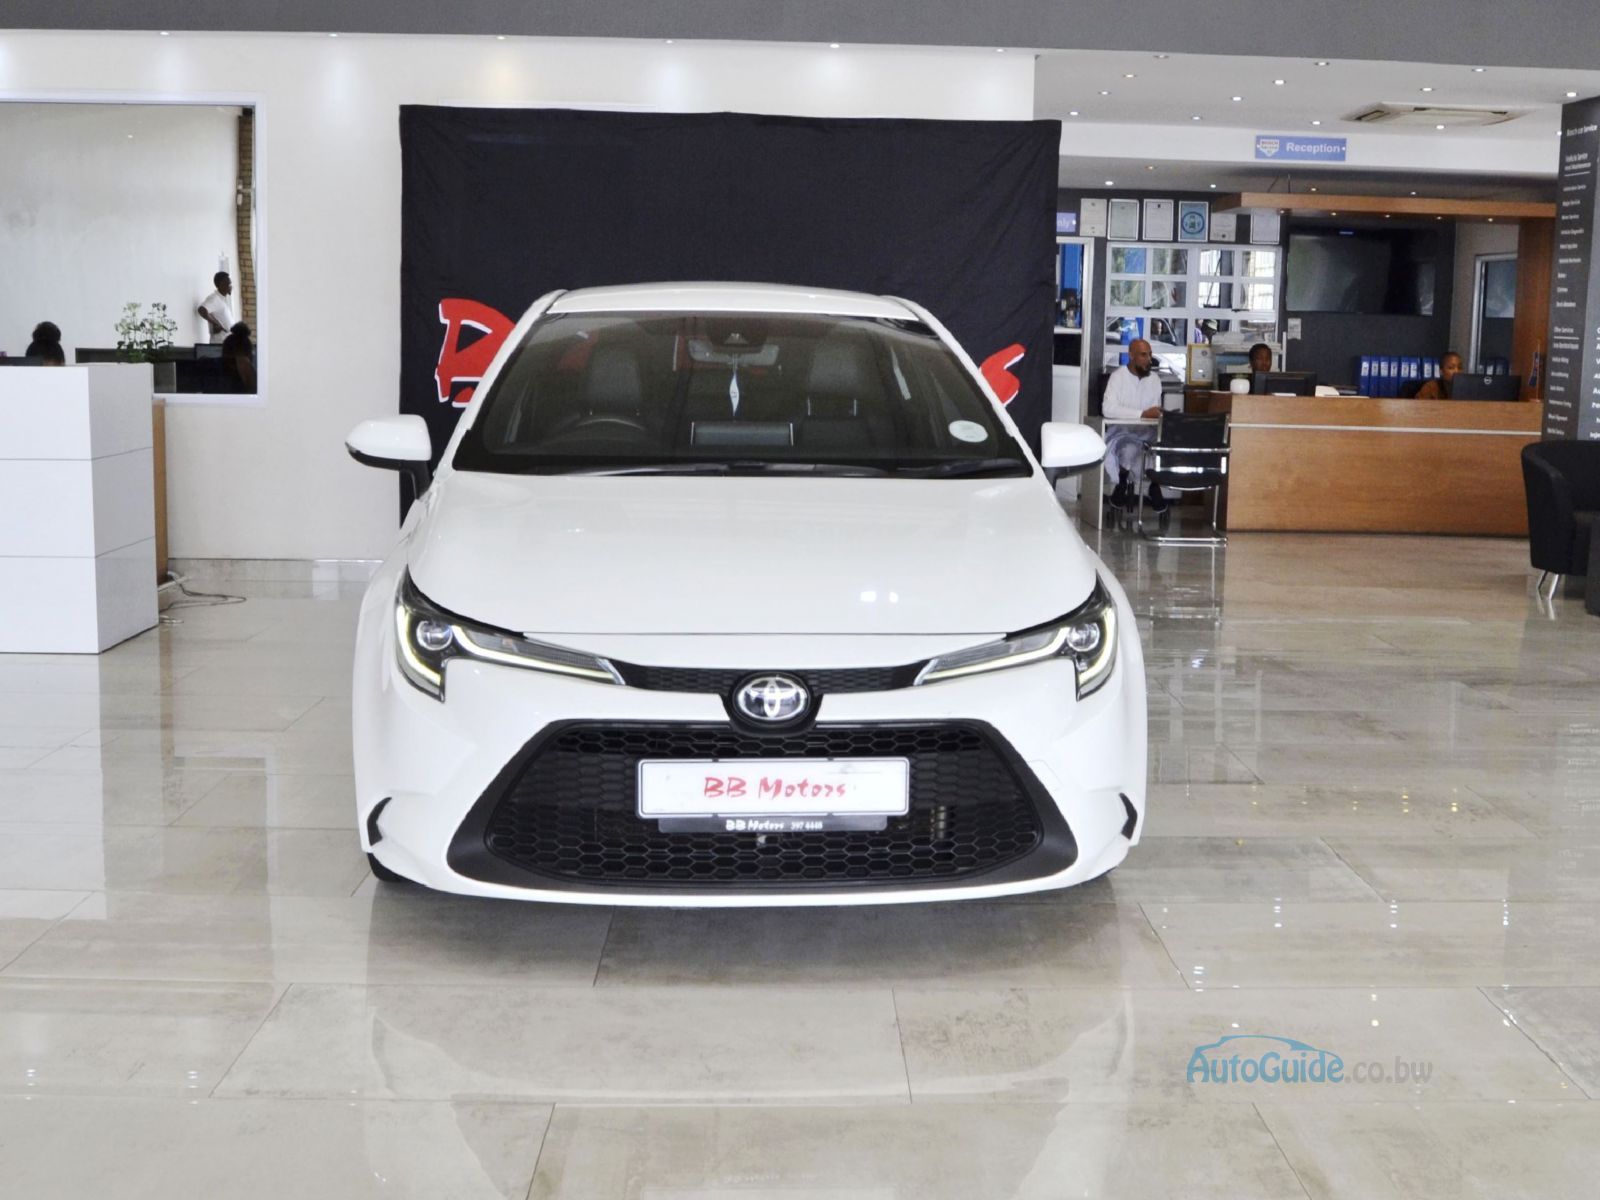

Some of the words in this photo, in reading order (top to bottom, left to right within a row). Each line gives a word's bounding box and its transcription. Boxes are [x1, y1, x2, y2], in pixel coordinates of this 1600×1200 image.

[1286, 142, 1340, 155] Reception
[704, 776, 747, 798] BB
[758, 776, 846, 800] Motors
[726, 819, 746, 831] BB
[748, 818, 785, 831] Motors
